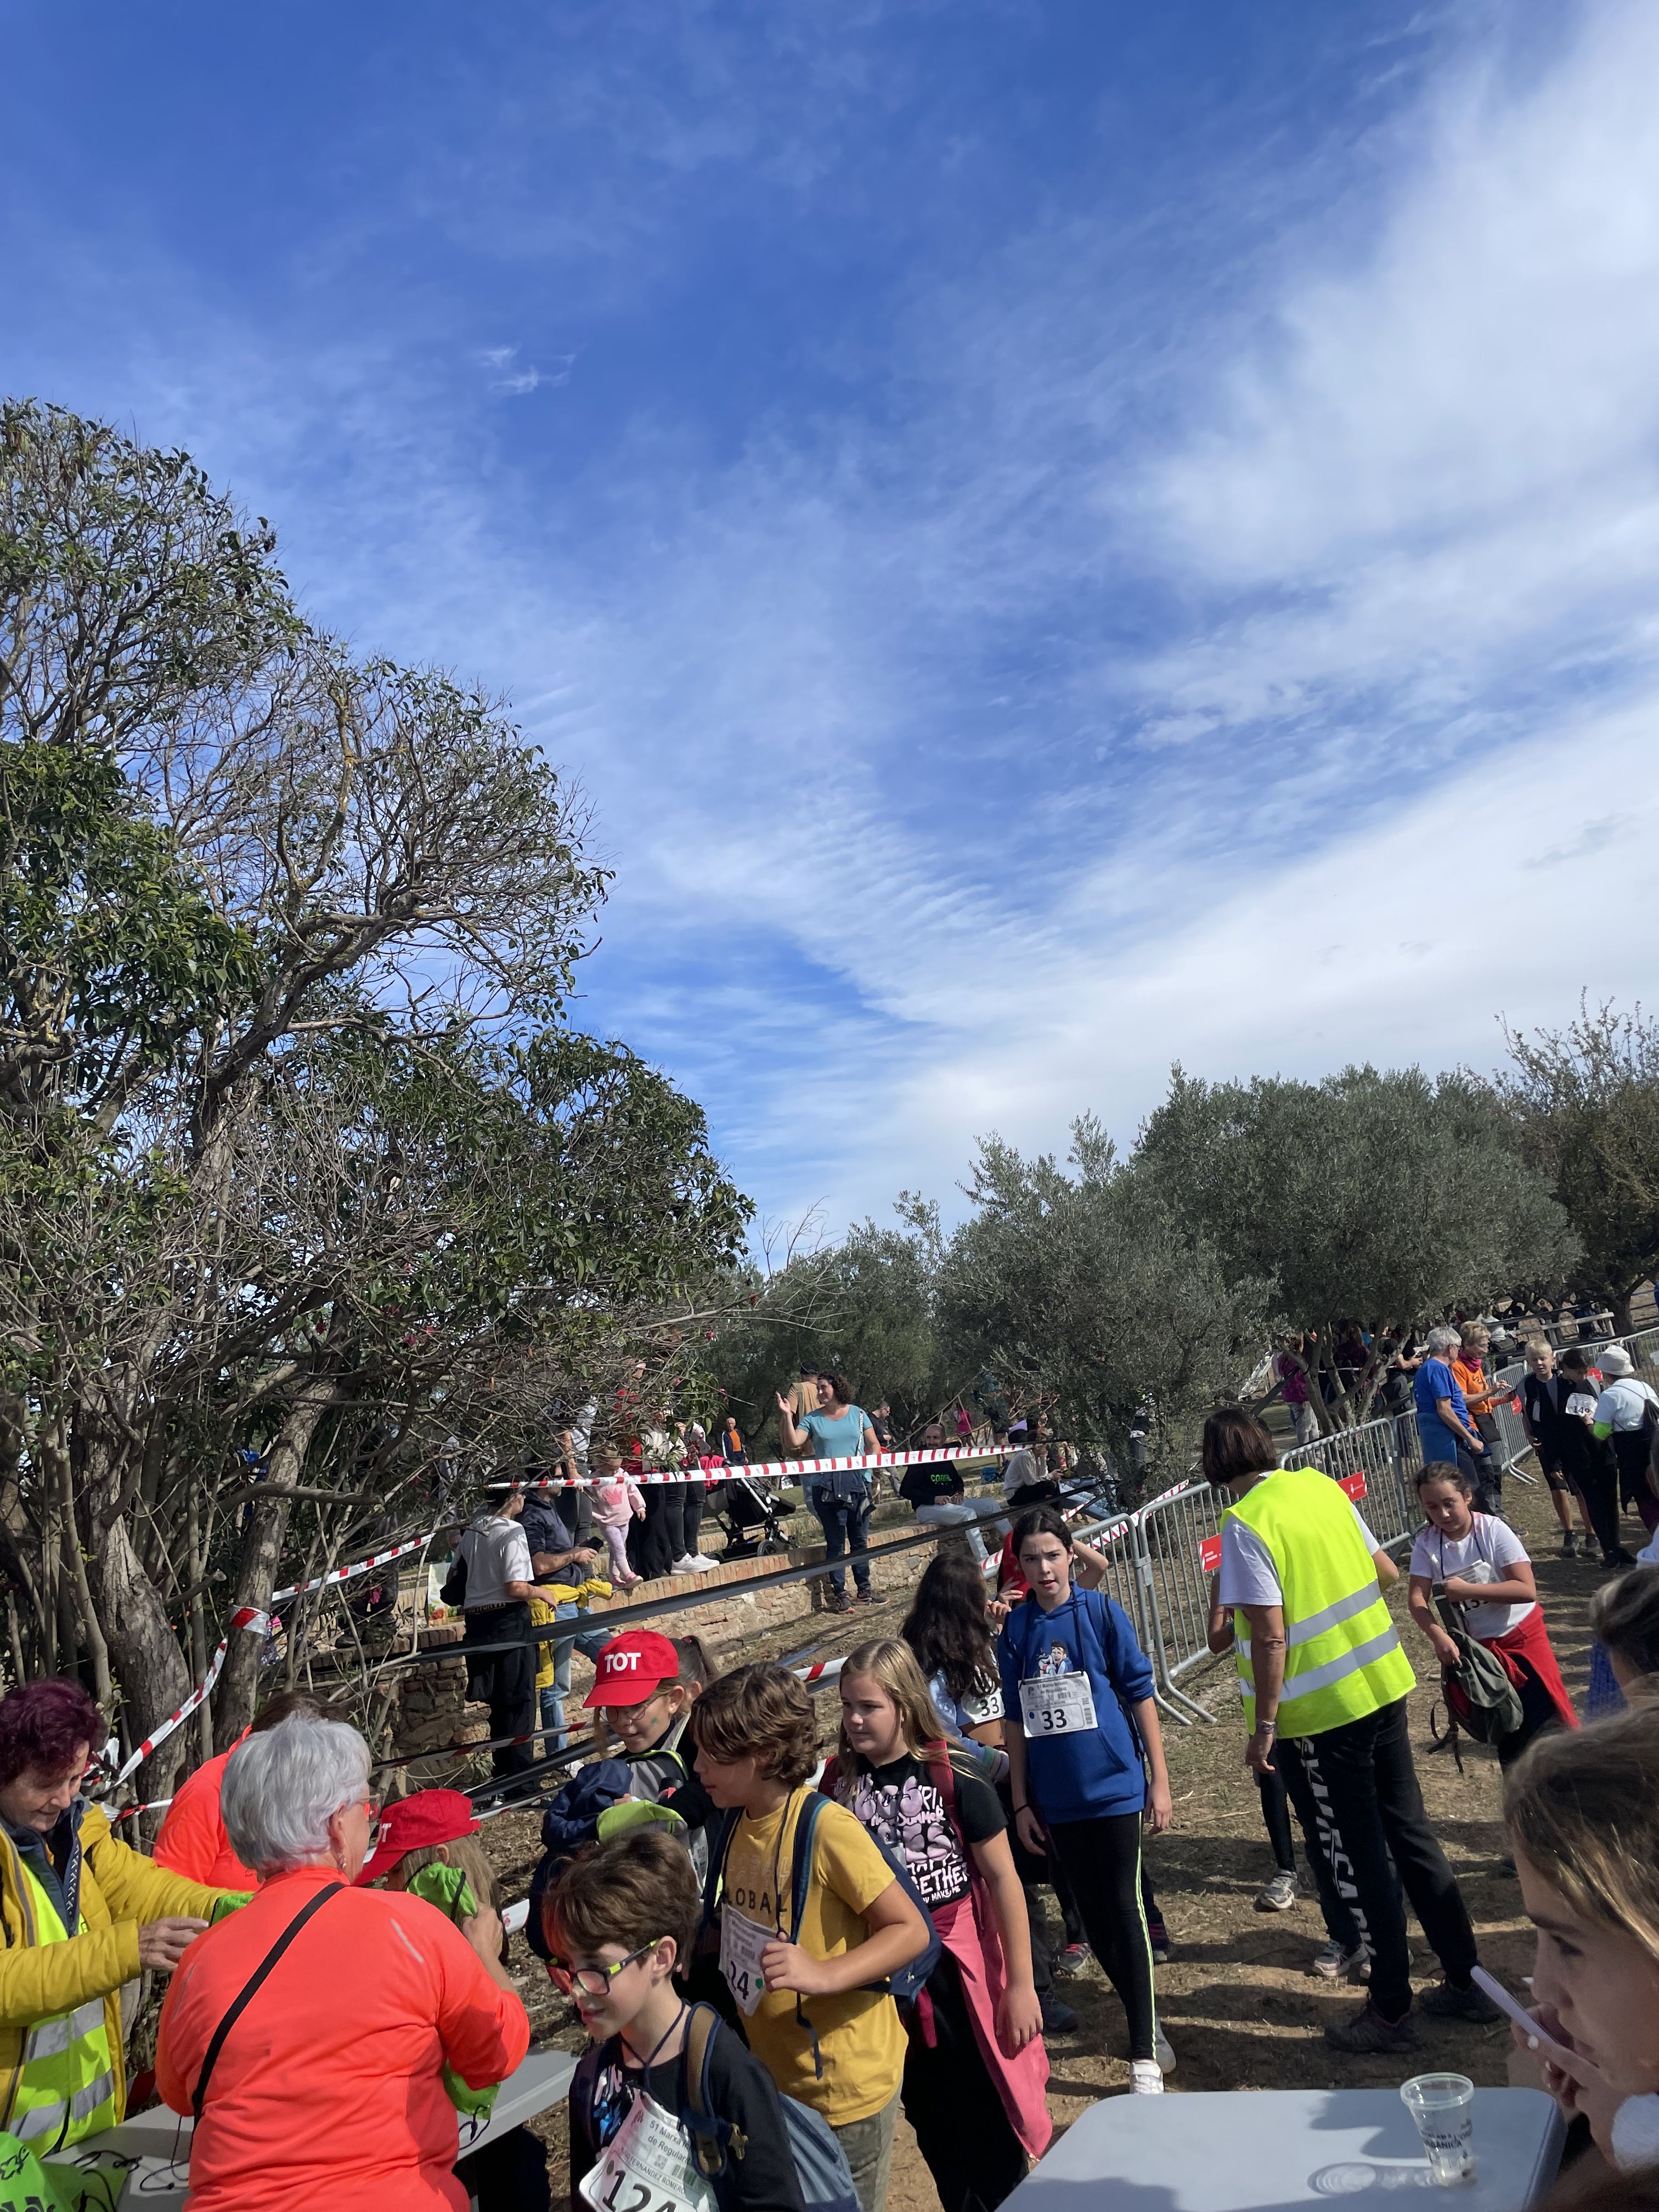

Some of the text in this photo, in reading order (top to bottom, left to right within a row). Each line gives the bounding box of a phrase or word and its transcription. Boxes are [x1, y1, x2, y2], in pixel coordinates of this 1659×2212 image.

[605, 1652, 641, 1673] TOT
[980, 1696, 1000, 1717] 33
[1042, 1709, 1067, 1730] 33
[931, 1888, 951, 1901] MAKE
[648, 2135, 657, 2145] de
[659, 2126, 681, 2146] Marxa
